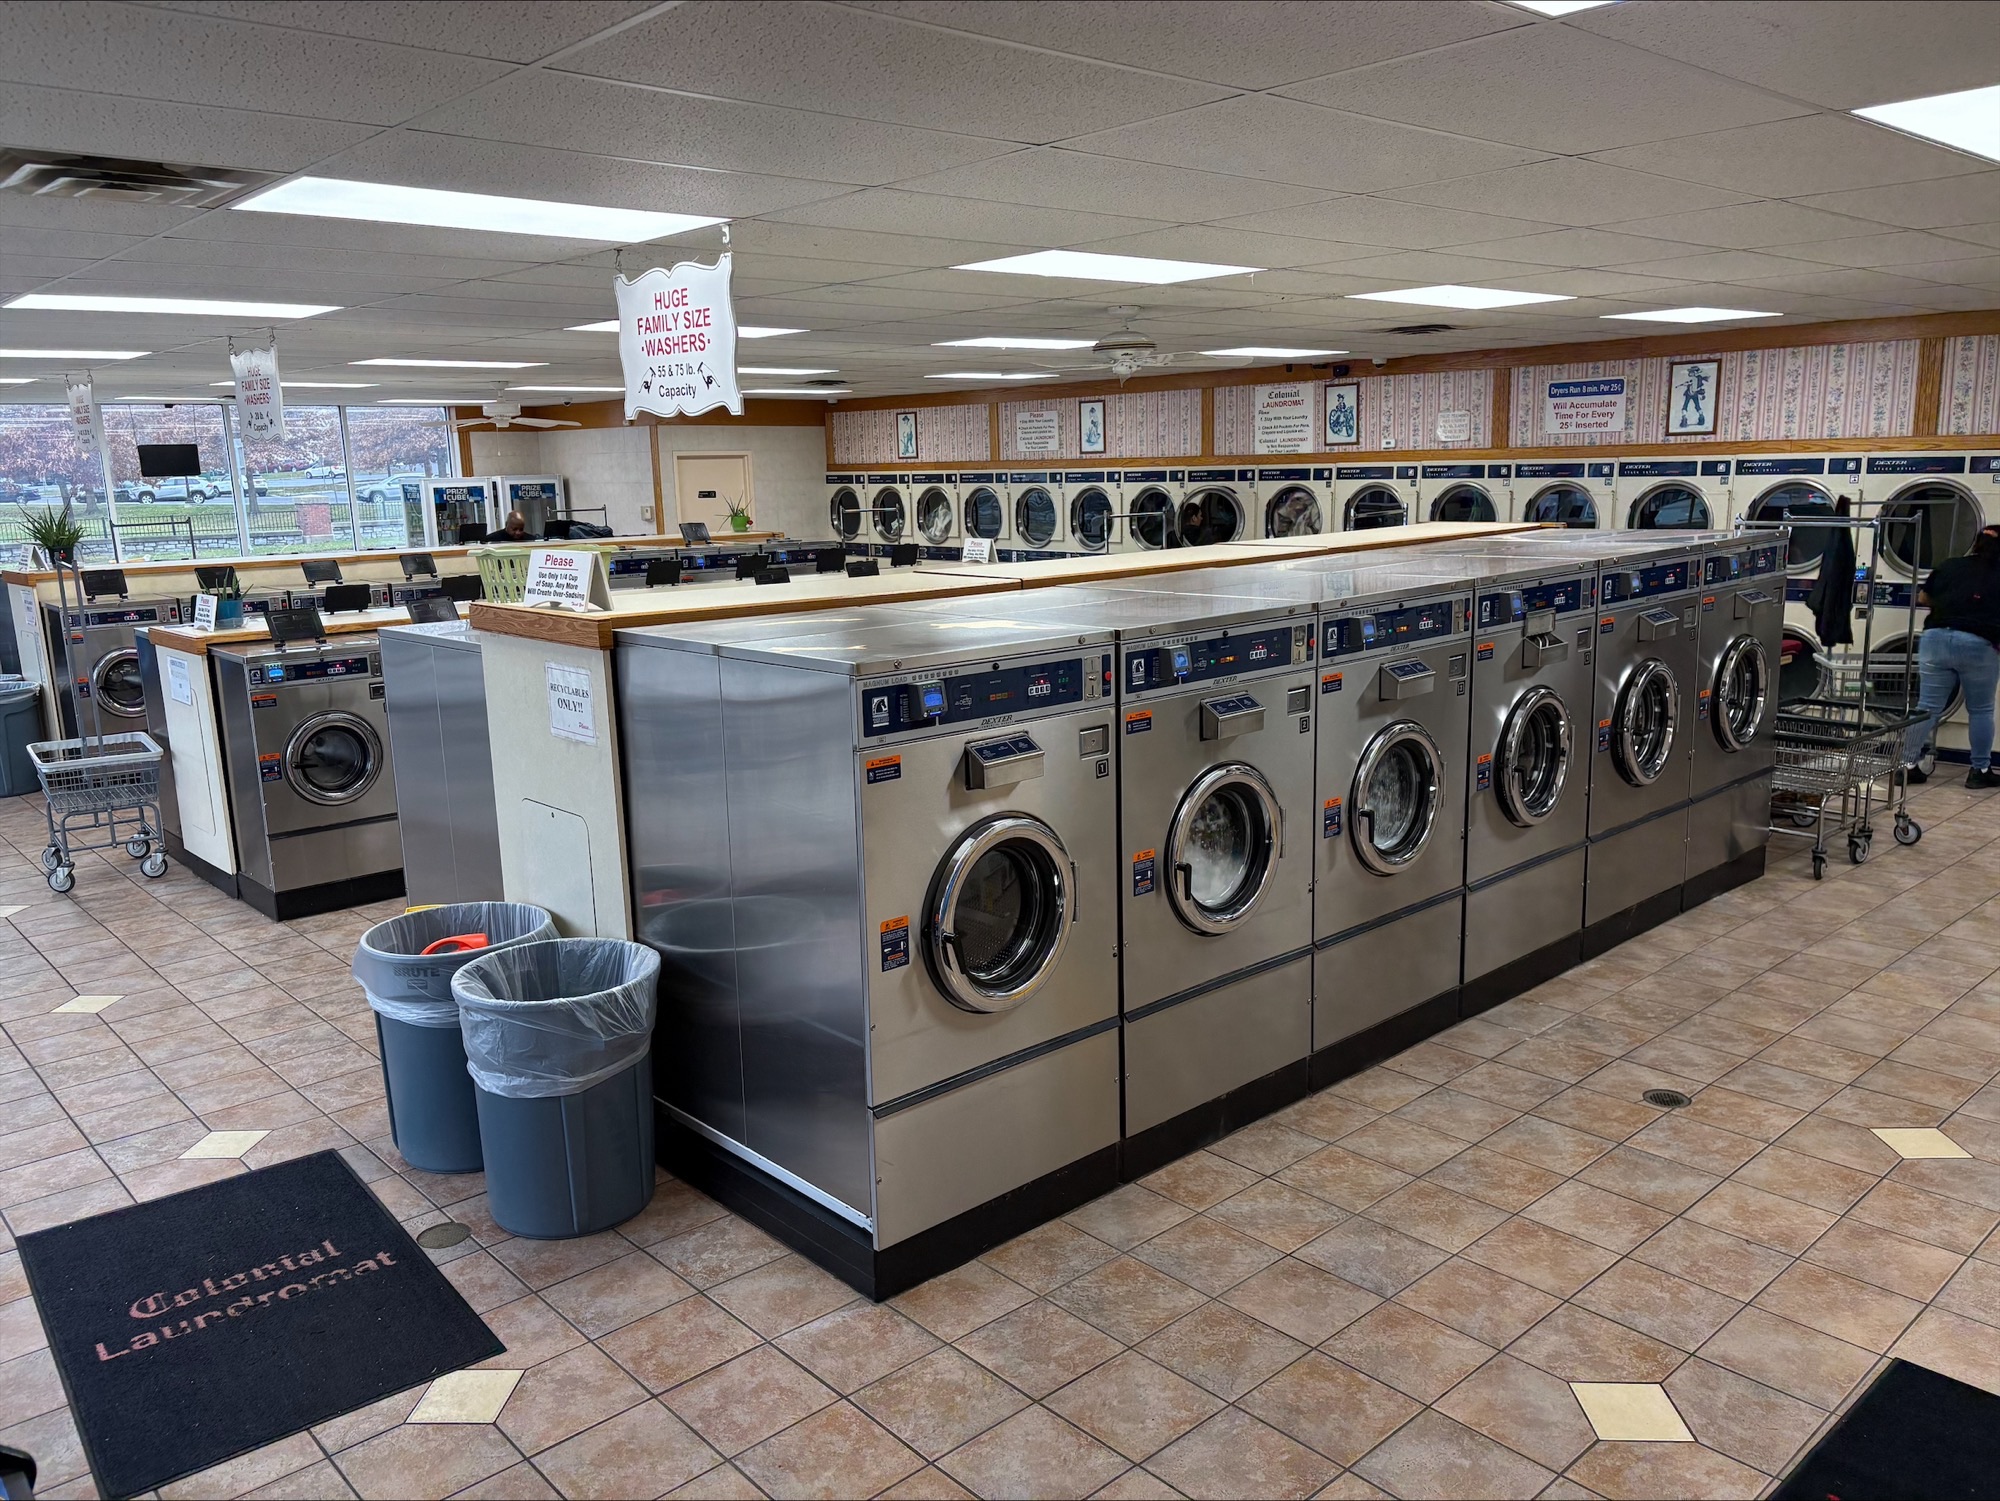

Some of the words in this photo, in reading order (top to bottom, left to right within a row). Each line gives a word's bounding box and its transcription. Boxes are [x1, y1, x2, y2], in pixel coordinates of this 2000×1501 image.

[654, 287, 689, 310] HUGE
[637, 312, 680, 335] FAMILY
[683, 307, 711, 330] SIZE
[657, 365, 666, 378] 55
[667, 364, 674, 377] &
[675, 363, 684, 376] 75
[685, 362, 696, 376] lb.
[241, 379, 259, 392] FAMILY
[259, 378, 271, 390] SIZE
[658, 383, 697, 400] Capacity
[1551, 386, 1569, 396] Dryers
[1582, 385, 1587, 393] 8
[1586, 384, 1599, 392] min.
[1600, 384, 1609, 392] Per
[1610, 383, 1622, 392] 25¢
[1268, 389, 1300, 399] Colonial
[1262, 399, 1305, 408] LAUNDROMAT
[1552, 402, 1568, 410] Will
[1569, 400, 1618, 410] Accumulate
[1554, 412, 1574, 420] Time
[1575, 411, 1590, 419] For
[1591, 411, 1615, 419] Every
[1575, 421, 1609, 429] Inserted
[544, 554, 574, 567] Please
[538, 571, 547, 579] Use
[547, 572, 559, 581] Only
[568, 573, 579, 583] Cup
[541, 580, 554, 589] Soap.
[555, 582, 565, 590] Any
[565, 582, 579, 590] More
[527, 587, 537, 595] Will
[536, 588, 552, 597] Create
[862, 678, 890, 688] MAGNUM
[891, 676, 908, 685] LOAD
[549, 682, 590, 699] RECYCLABLES
[557, 697, 584, 713] ONLY!!
[980, 714, 1013, 725] DEXTER
[128, 1239, 343, 1319] Colonial
[95, 1249, 398, 1362] Laundromat
